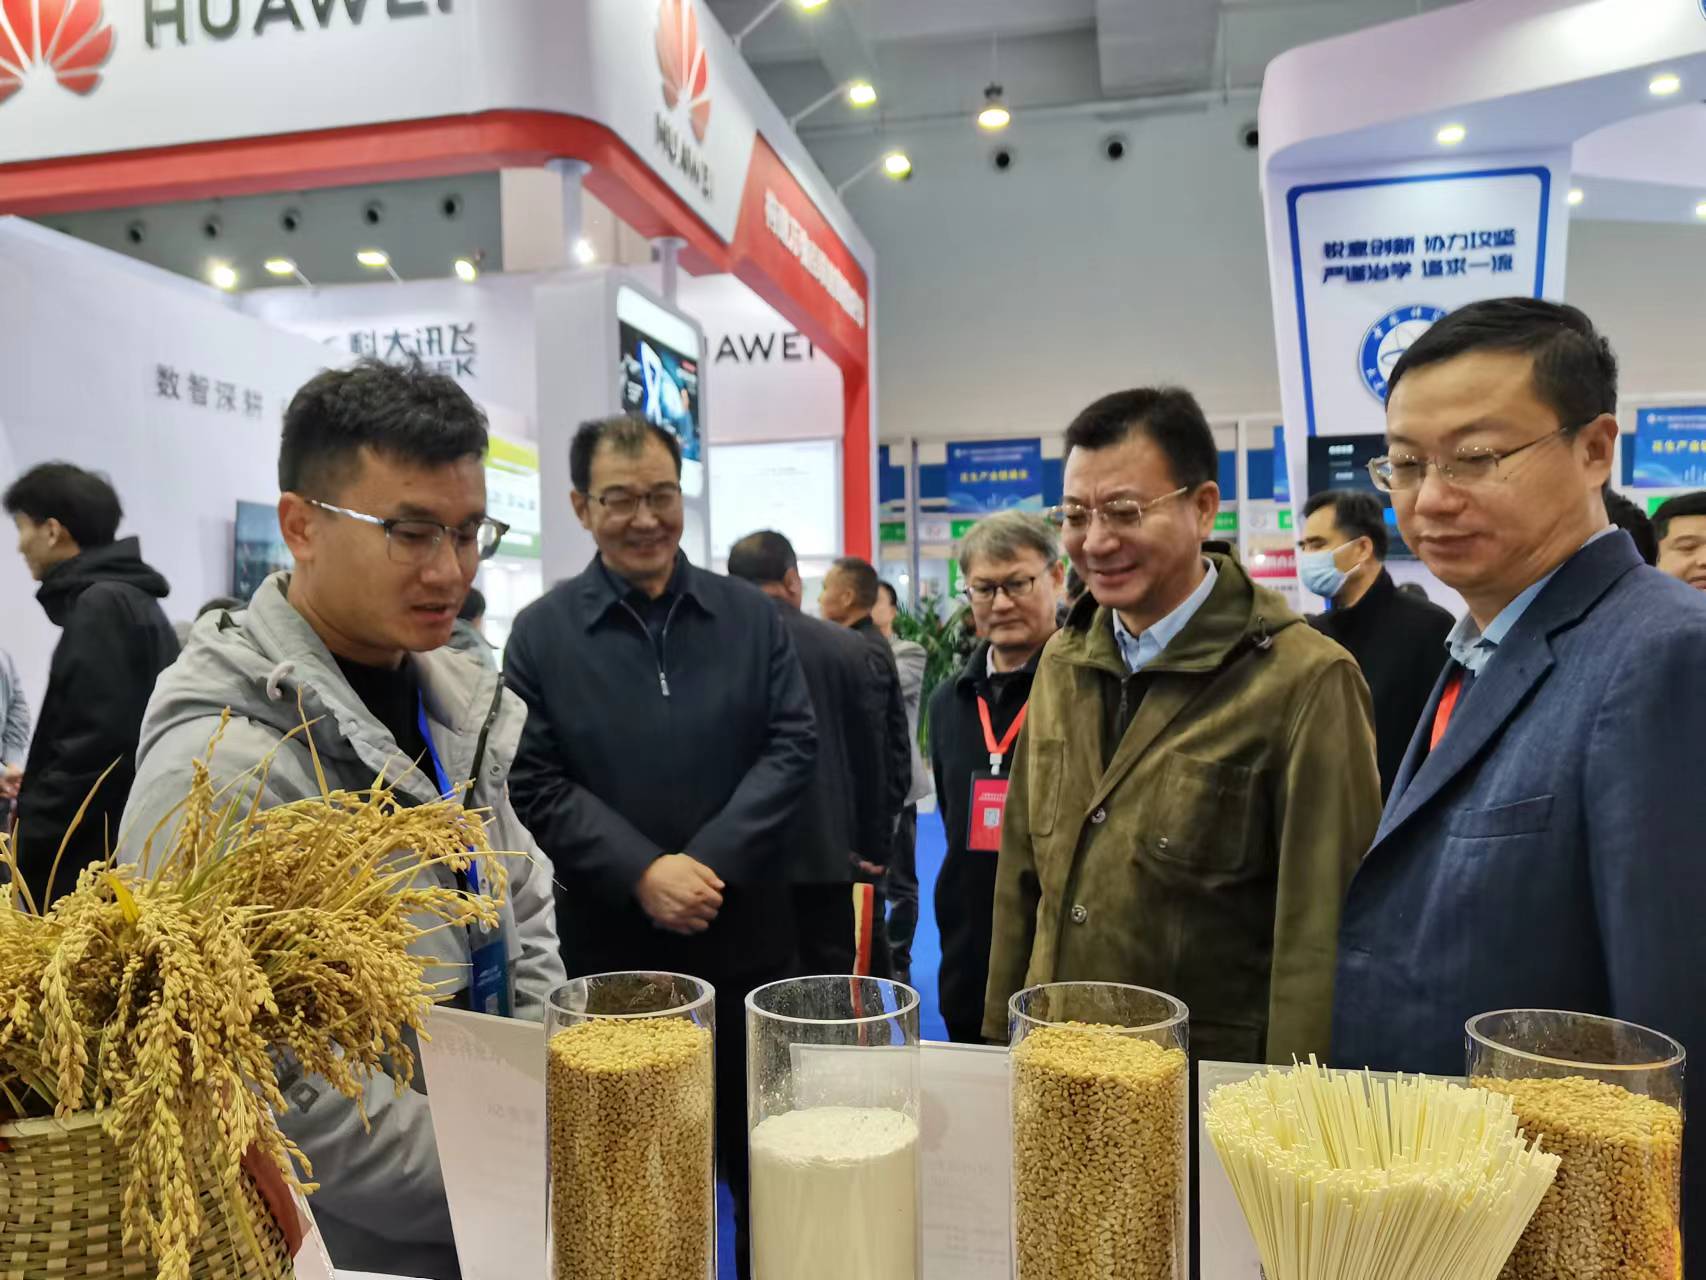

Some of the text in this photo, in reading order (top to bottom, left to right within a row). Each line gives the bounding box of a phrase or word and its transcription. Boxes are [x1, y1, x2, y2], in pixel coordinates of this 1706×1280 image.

[144, 0, 453, 48] HUAW
[349, 321, 476, 360] 科大讯飞
[703, 332, 813, 362] AWEI
